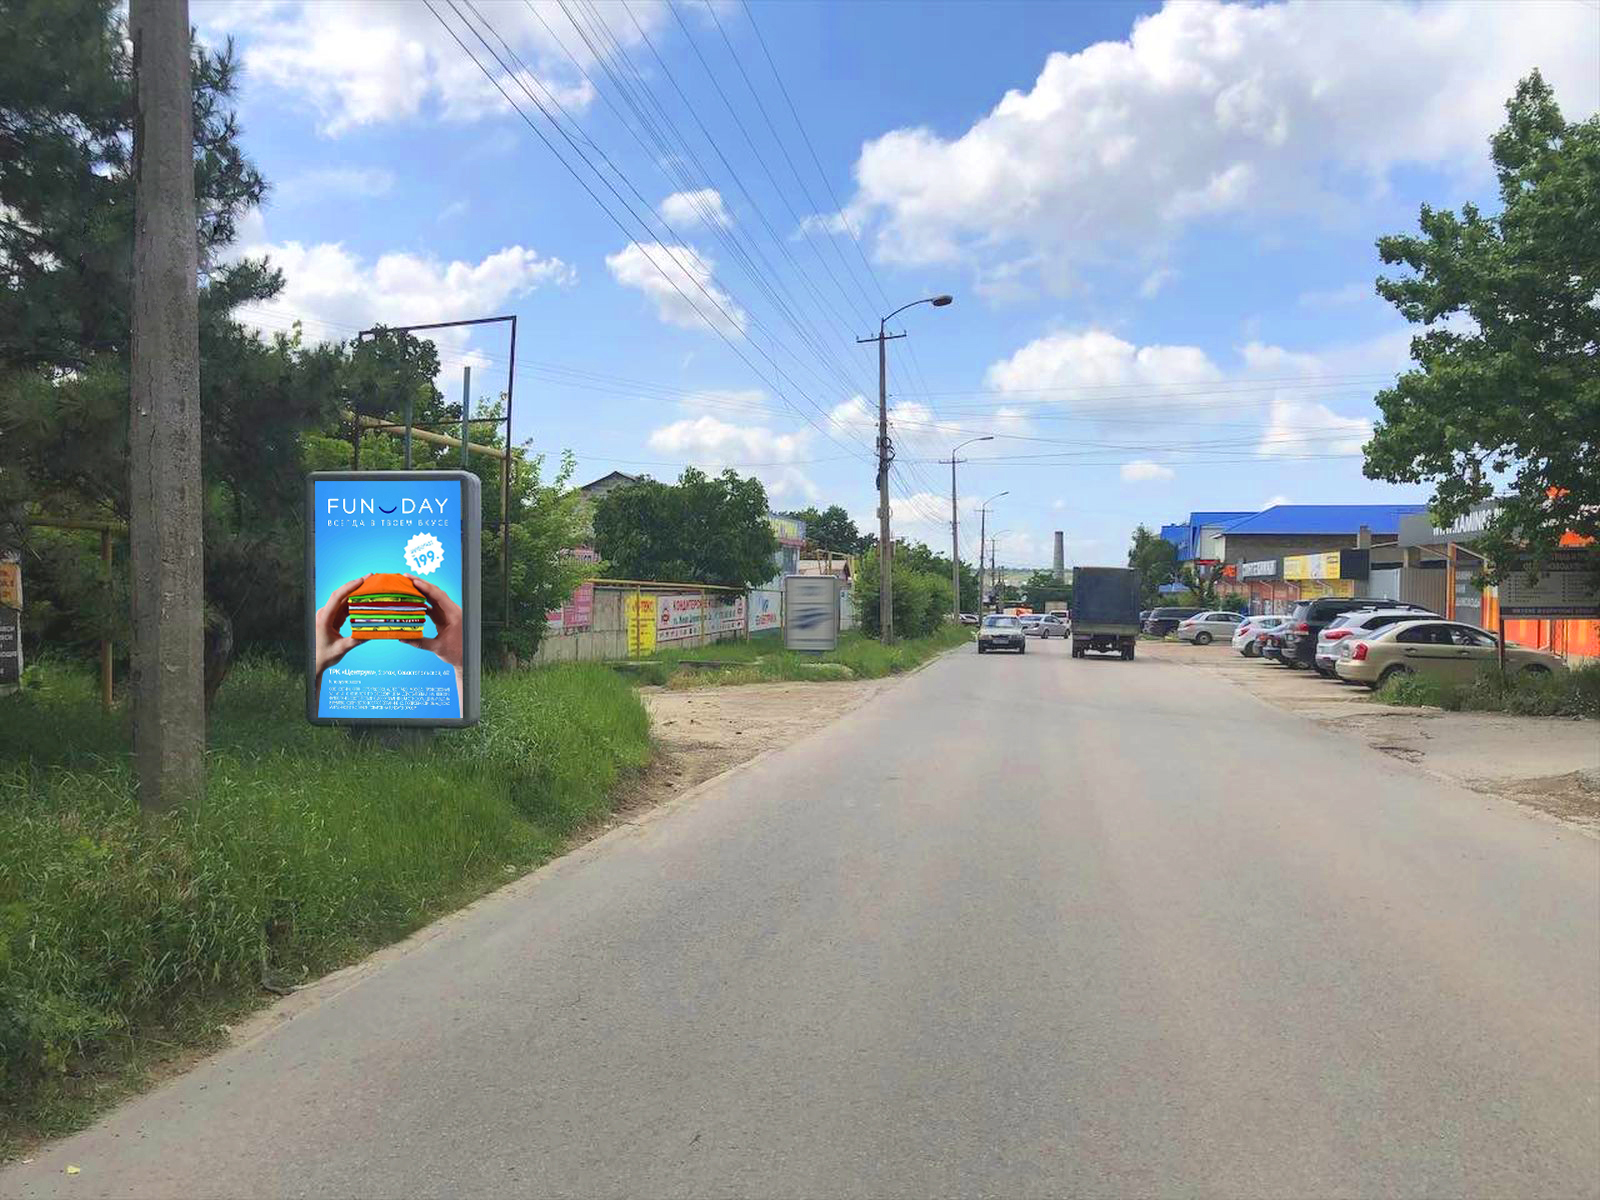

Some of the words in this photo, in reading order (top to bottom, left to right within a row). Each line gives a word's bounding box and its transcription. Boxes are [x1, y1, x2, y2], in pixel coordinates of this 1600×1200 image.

[327, 498, 374, 514] FUN
[401, 498, 448, 514] DAY
[327, 519, 366, 528] ВСЕГДА
[380, 519, 413, 527] ТВОЕМ
[328, 668, 341, 676] ТРК
